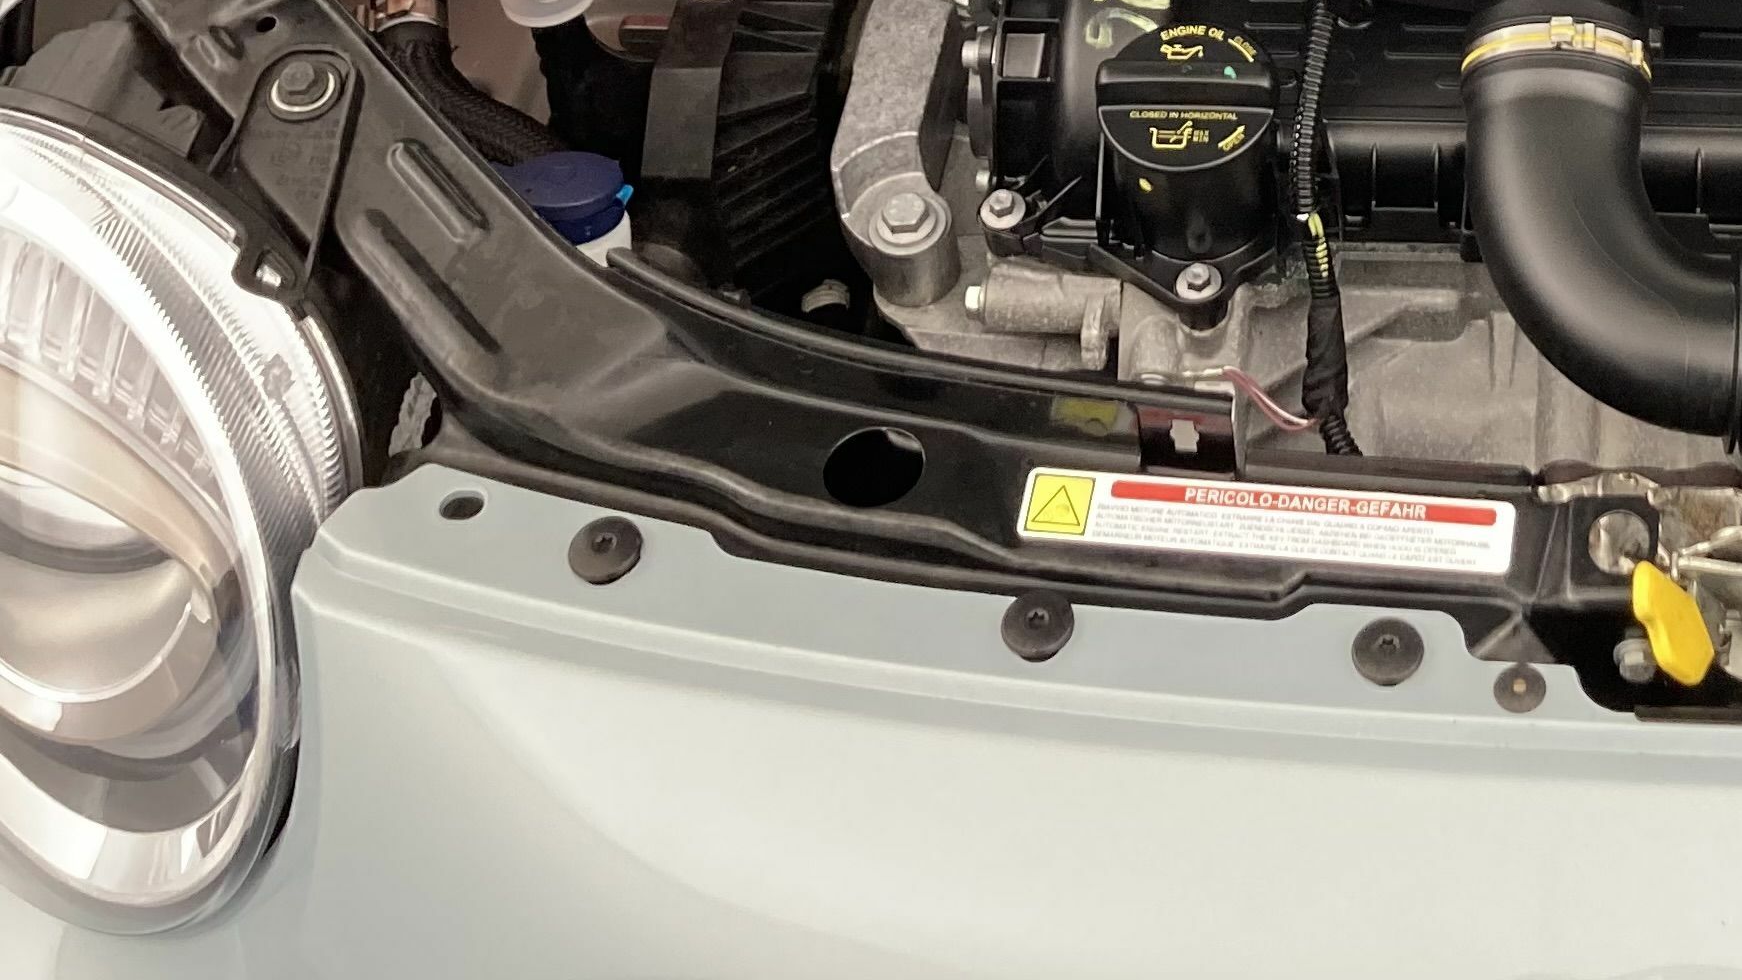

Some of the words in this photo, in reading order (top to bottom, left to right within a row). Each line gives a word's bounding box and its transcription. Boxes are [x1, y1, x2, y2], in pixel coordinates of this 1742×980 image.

[1160, 25, 1206, 41] ENGINE
[1208, 27, 1225, 42] OIL
[1129, 109, 1168, 120] CLOSED
[1169, 110, 1179, 119] IN
[1181, 111, 1239, 121] HORIZONTAL
[1185, 487, 1426, 520] PERICOLO-DANGER-GEFAHR
